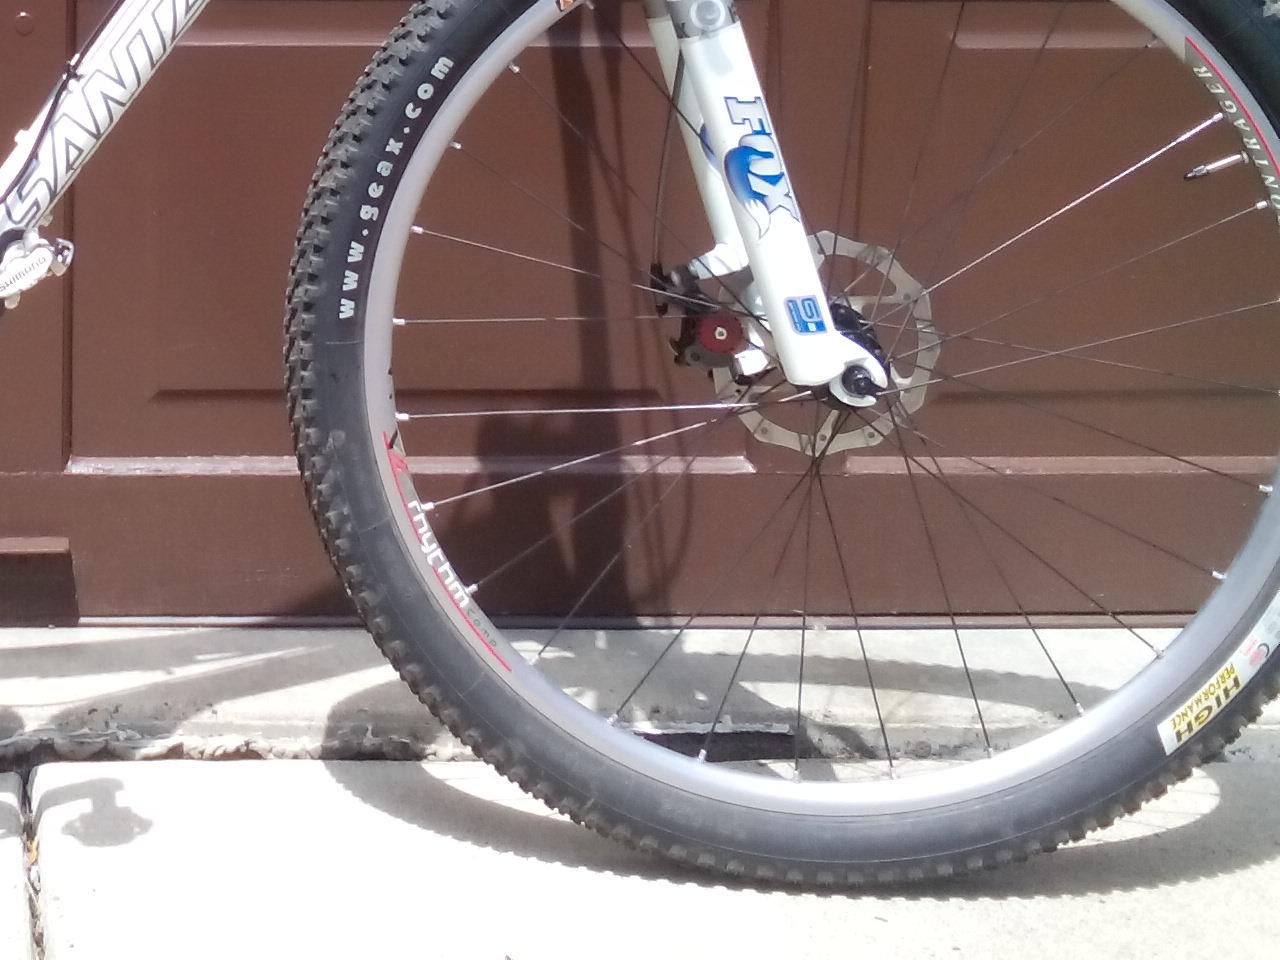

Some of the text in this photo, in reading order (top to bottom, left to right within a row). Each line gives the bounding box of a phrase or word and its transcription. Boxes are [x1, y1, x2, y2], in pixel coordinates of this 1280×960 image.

[339, 56, 455, 320] www.geax.com
[723, 95, 801, 223] FOX
[1193, 65, 1280, 226] ONTRAGER
[1174, 676, 1241, 743] HIGH
